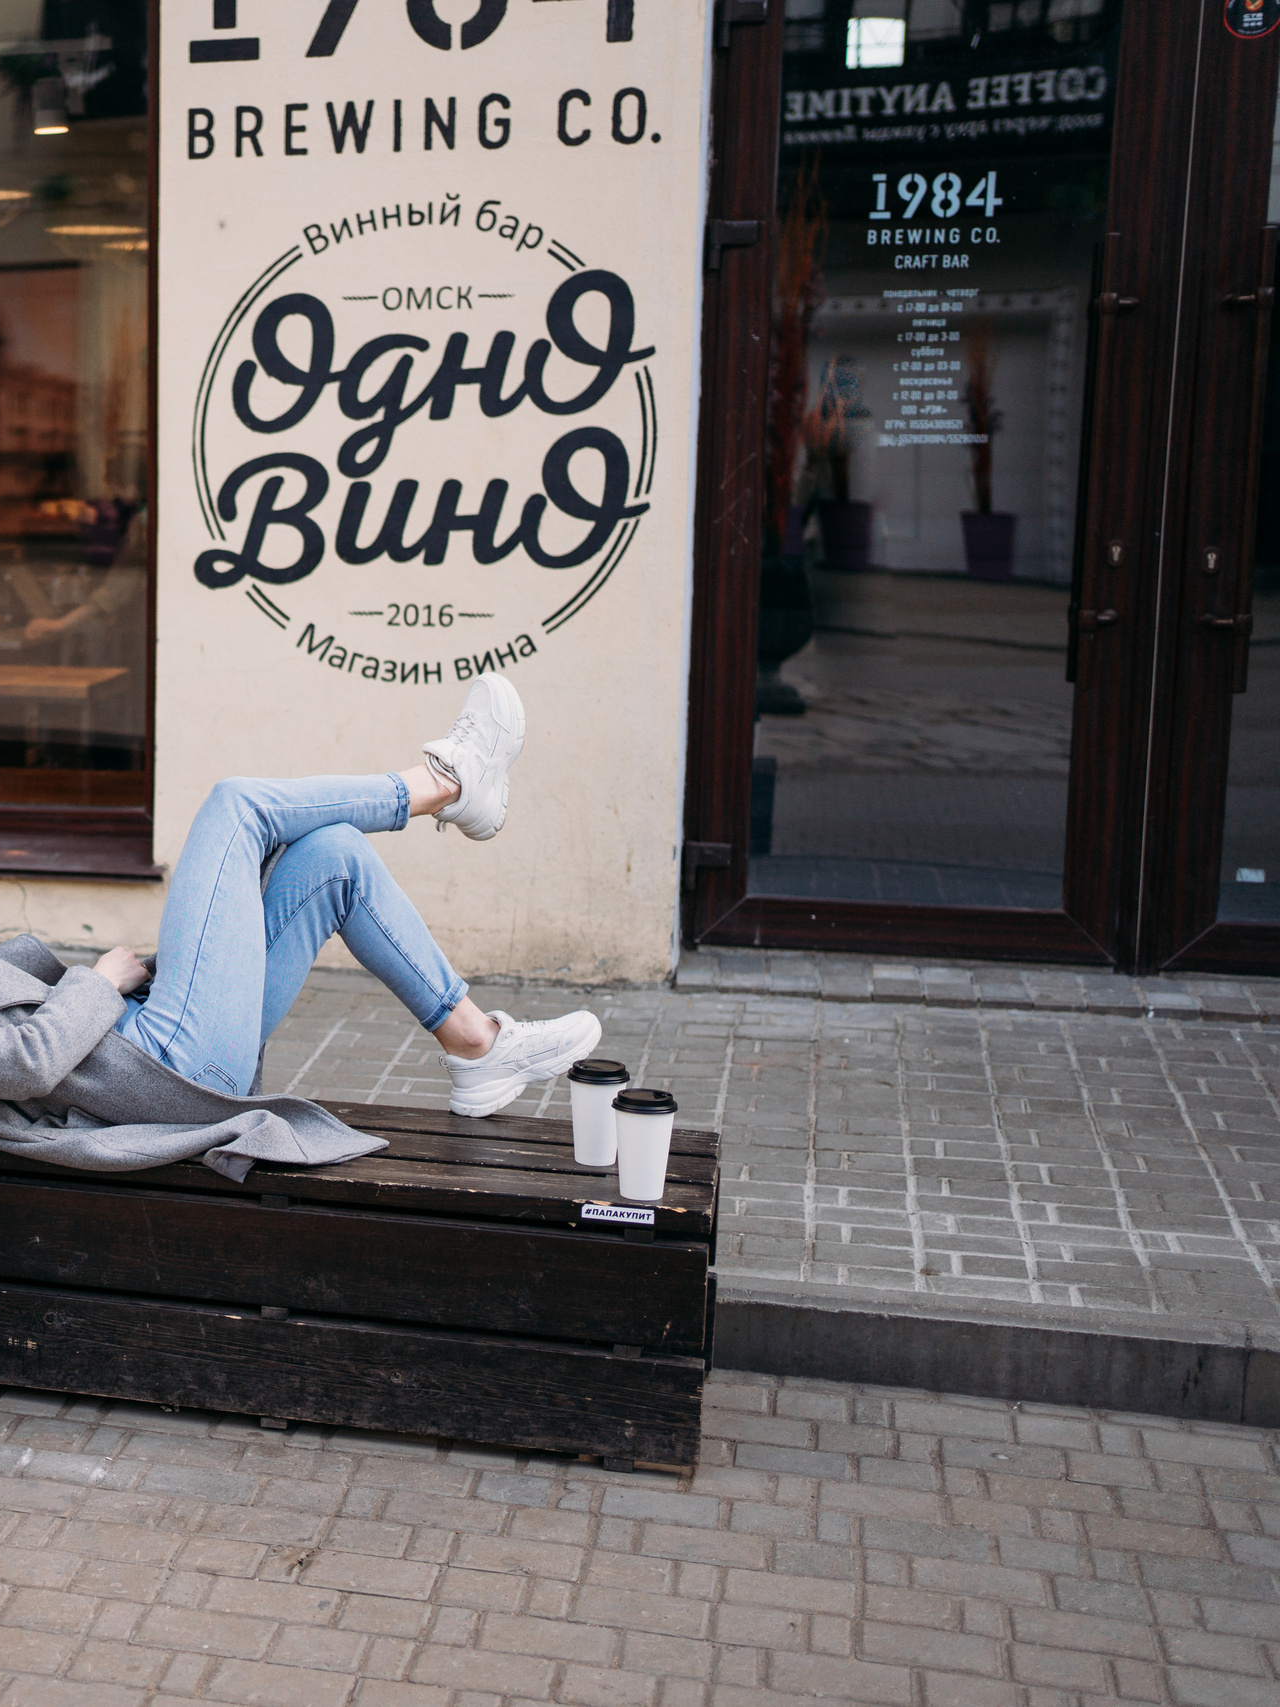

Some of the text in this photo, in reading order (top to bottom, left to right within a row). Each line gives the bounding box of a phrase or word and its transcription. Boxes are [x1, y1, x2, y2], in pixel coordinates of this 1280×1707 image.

[188, 87, 661, 160] BREWING CO.
[869, 171, 1003, 220] 1984
[303, 193, 544, 255] Винный бар
[867, 227, 1001, 245] BREWING CO.
[894, 254, 969, 270] CRAFT BAR
[382, 286, 472, 310] ОМСК
[387, 603, 454, 627] 2016
[296, 623, 537, 684] Магазин вина
[584, 1208, 652, 1220] #ПАПАКУПИТ
